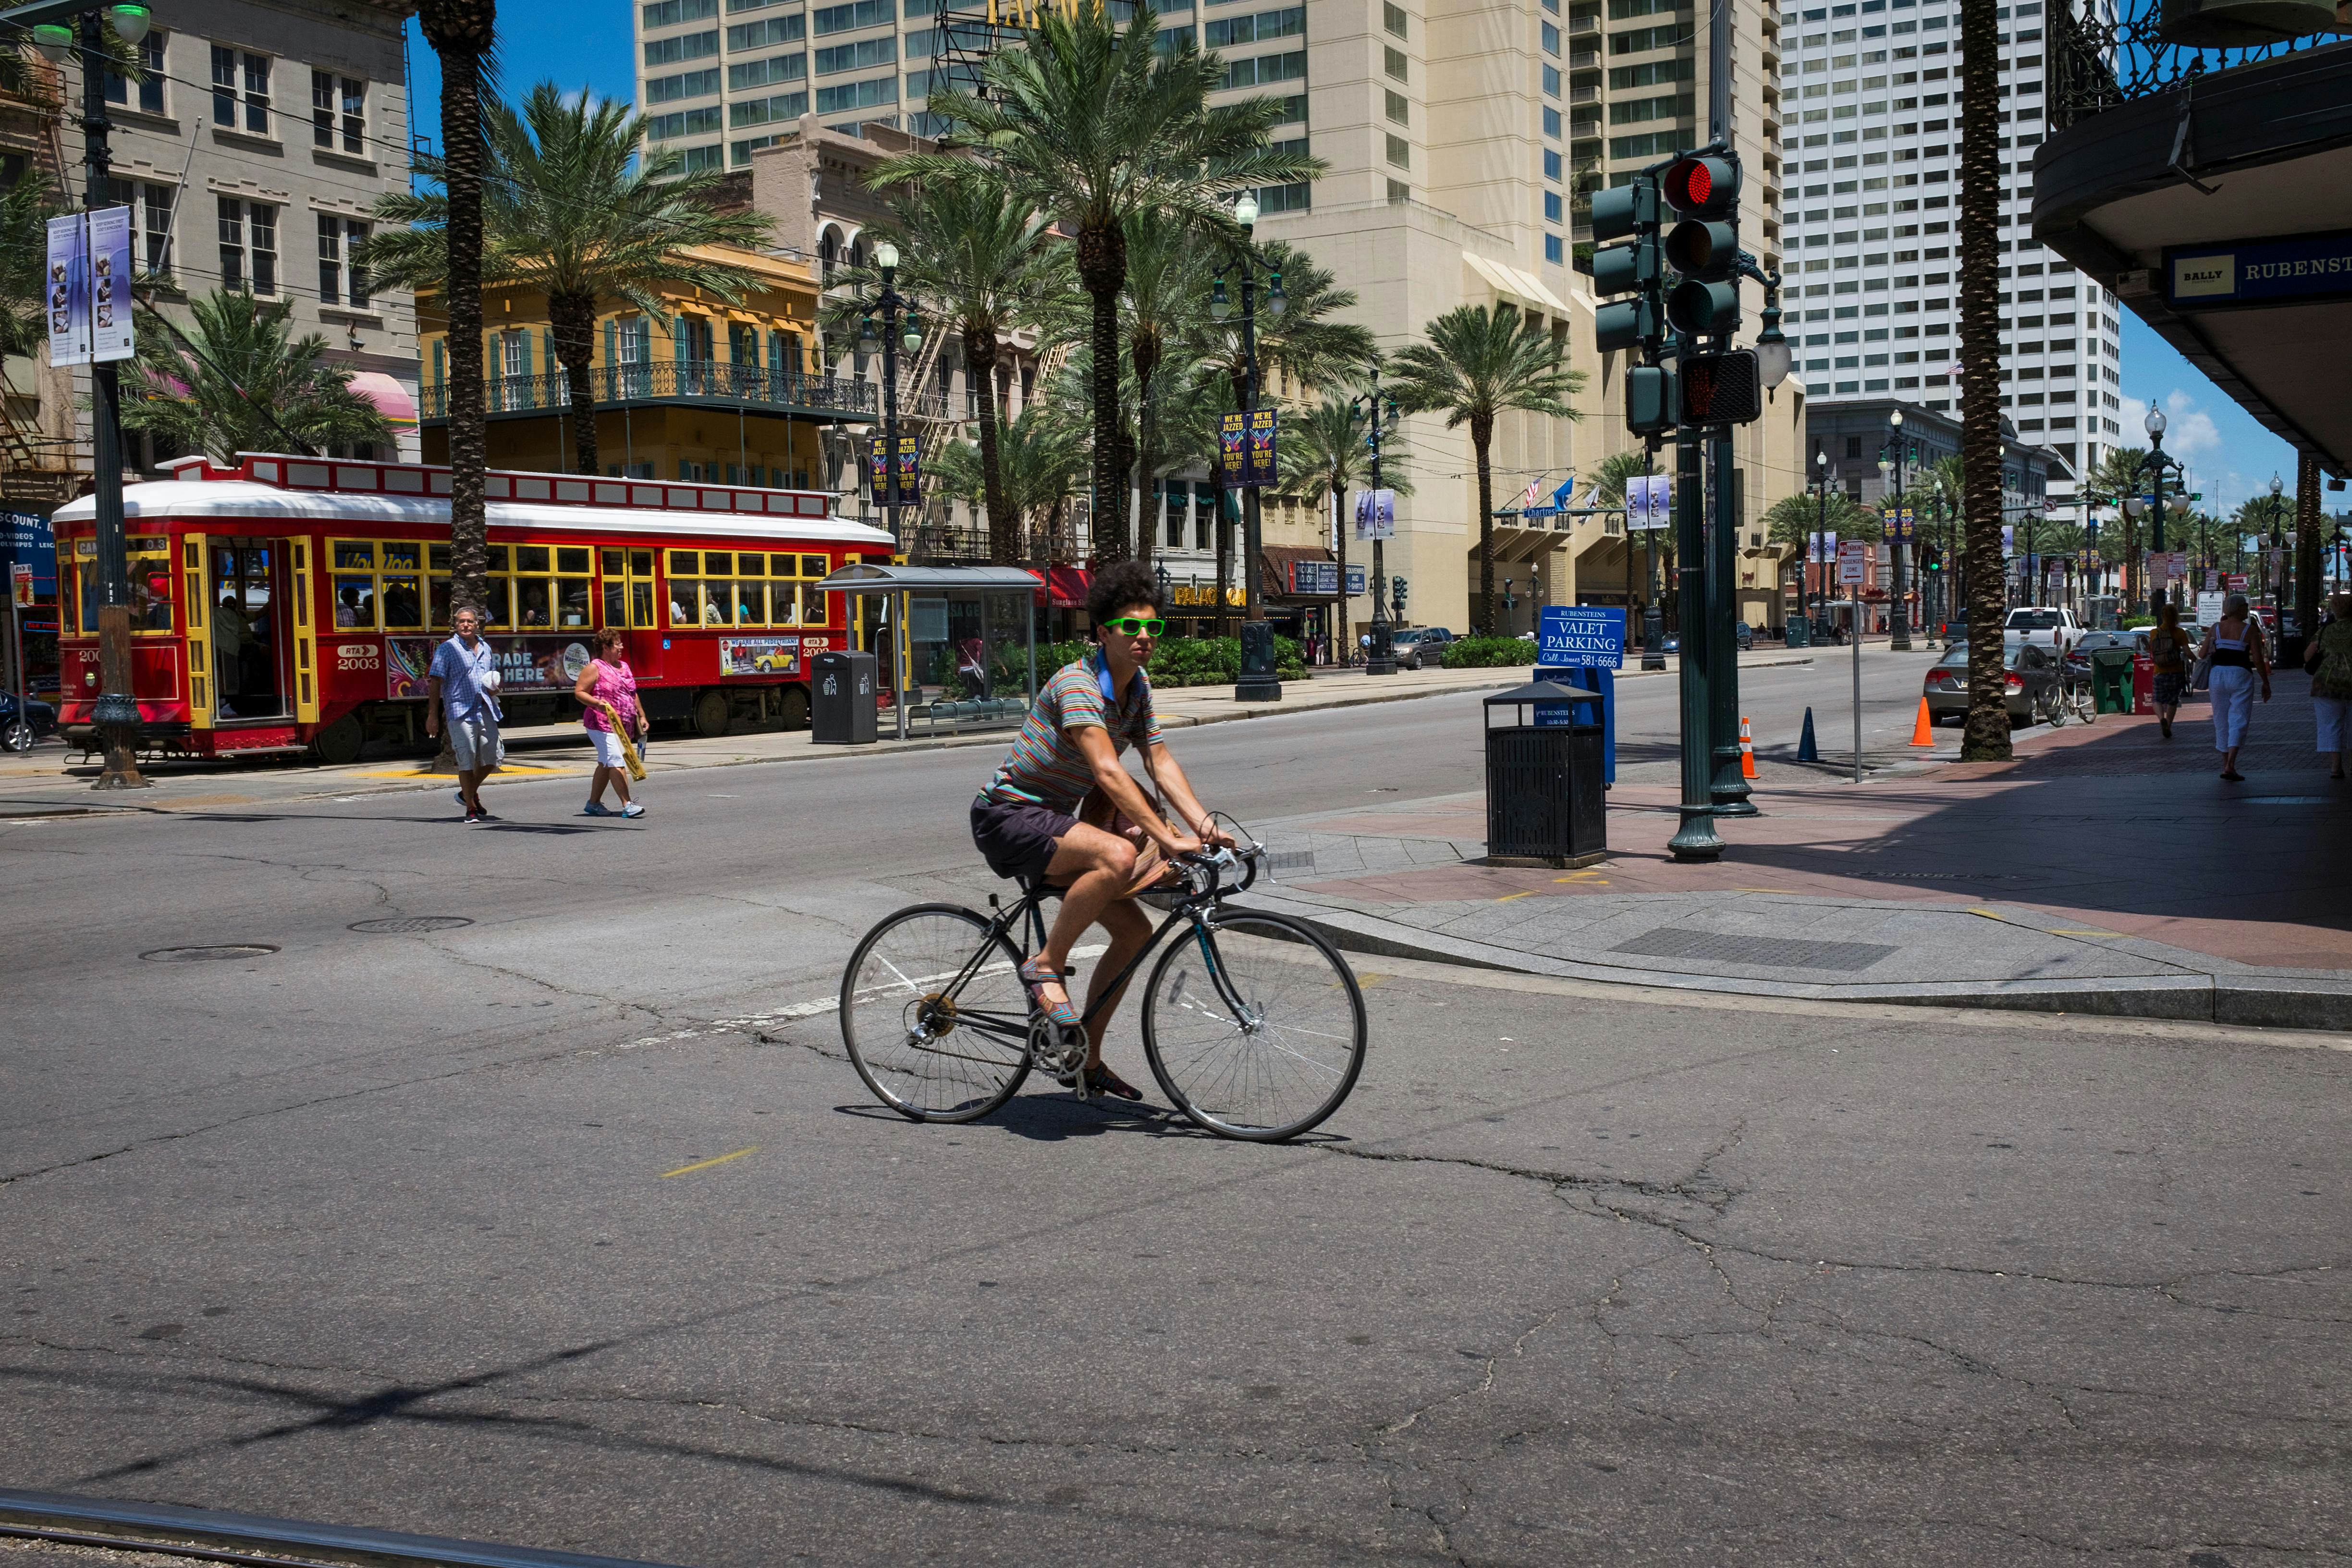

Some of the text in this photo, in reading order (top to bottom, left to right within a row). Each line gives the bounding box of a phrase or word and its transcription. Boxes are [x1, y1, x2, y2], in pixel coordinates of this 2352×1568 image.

[2245, 257, 2352, 280] RUBENST
[2184, 270, 2222, 281] BALLY
[1225, 415, 1243, 423] WE'RE
[1254, 412, 1272, 420] WE'RE
[1223, 423, 1243, 431] JAZZED
[1252, 420, 1273, 429] JAZZED
[1223, 452, 1243, 461] YOU'RE
[1251, 450, 1273, 459] YOU'RE
[1225, 461, 1242, 469] HERE!
[1254, 459, 1271, 467] HERE!
[1528, 508, 1555, 517] Chartres
[1840, 545, 1847, 553] NO
[1297, 565, 1316, 574] PACKAGE
[1559, 622, 1607, 635] VALET
[1546, 636, 1617, 650] PARKING
[338, 658, 380, 670] 2003
[1543, 653, 1617, 667] Call James 581-6666
[504, 668, 545, 682] HERE
